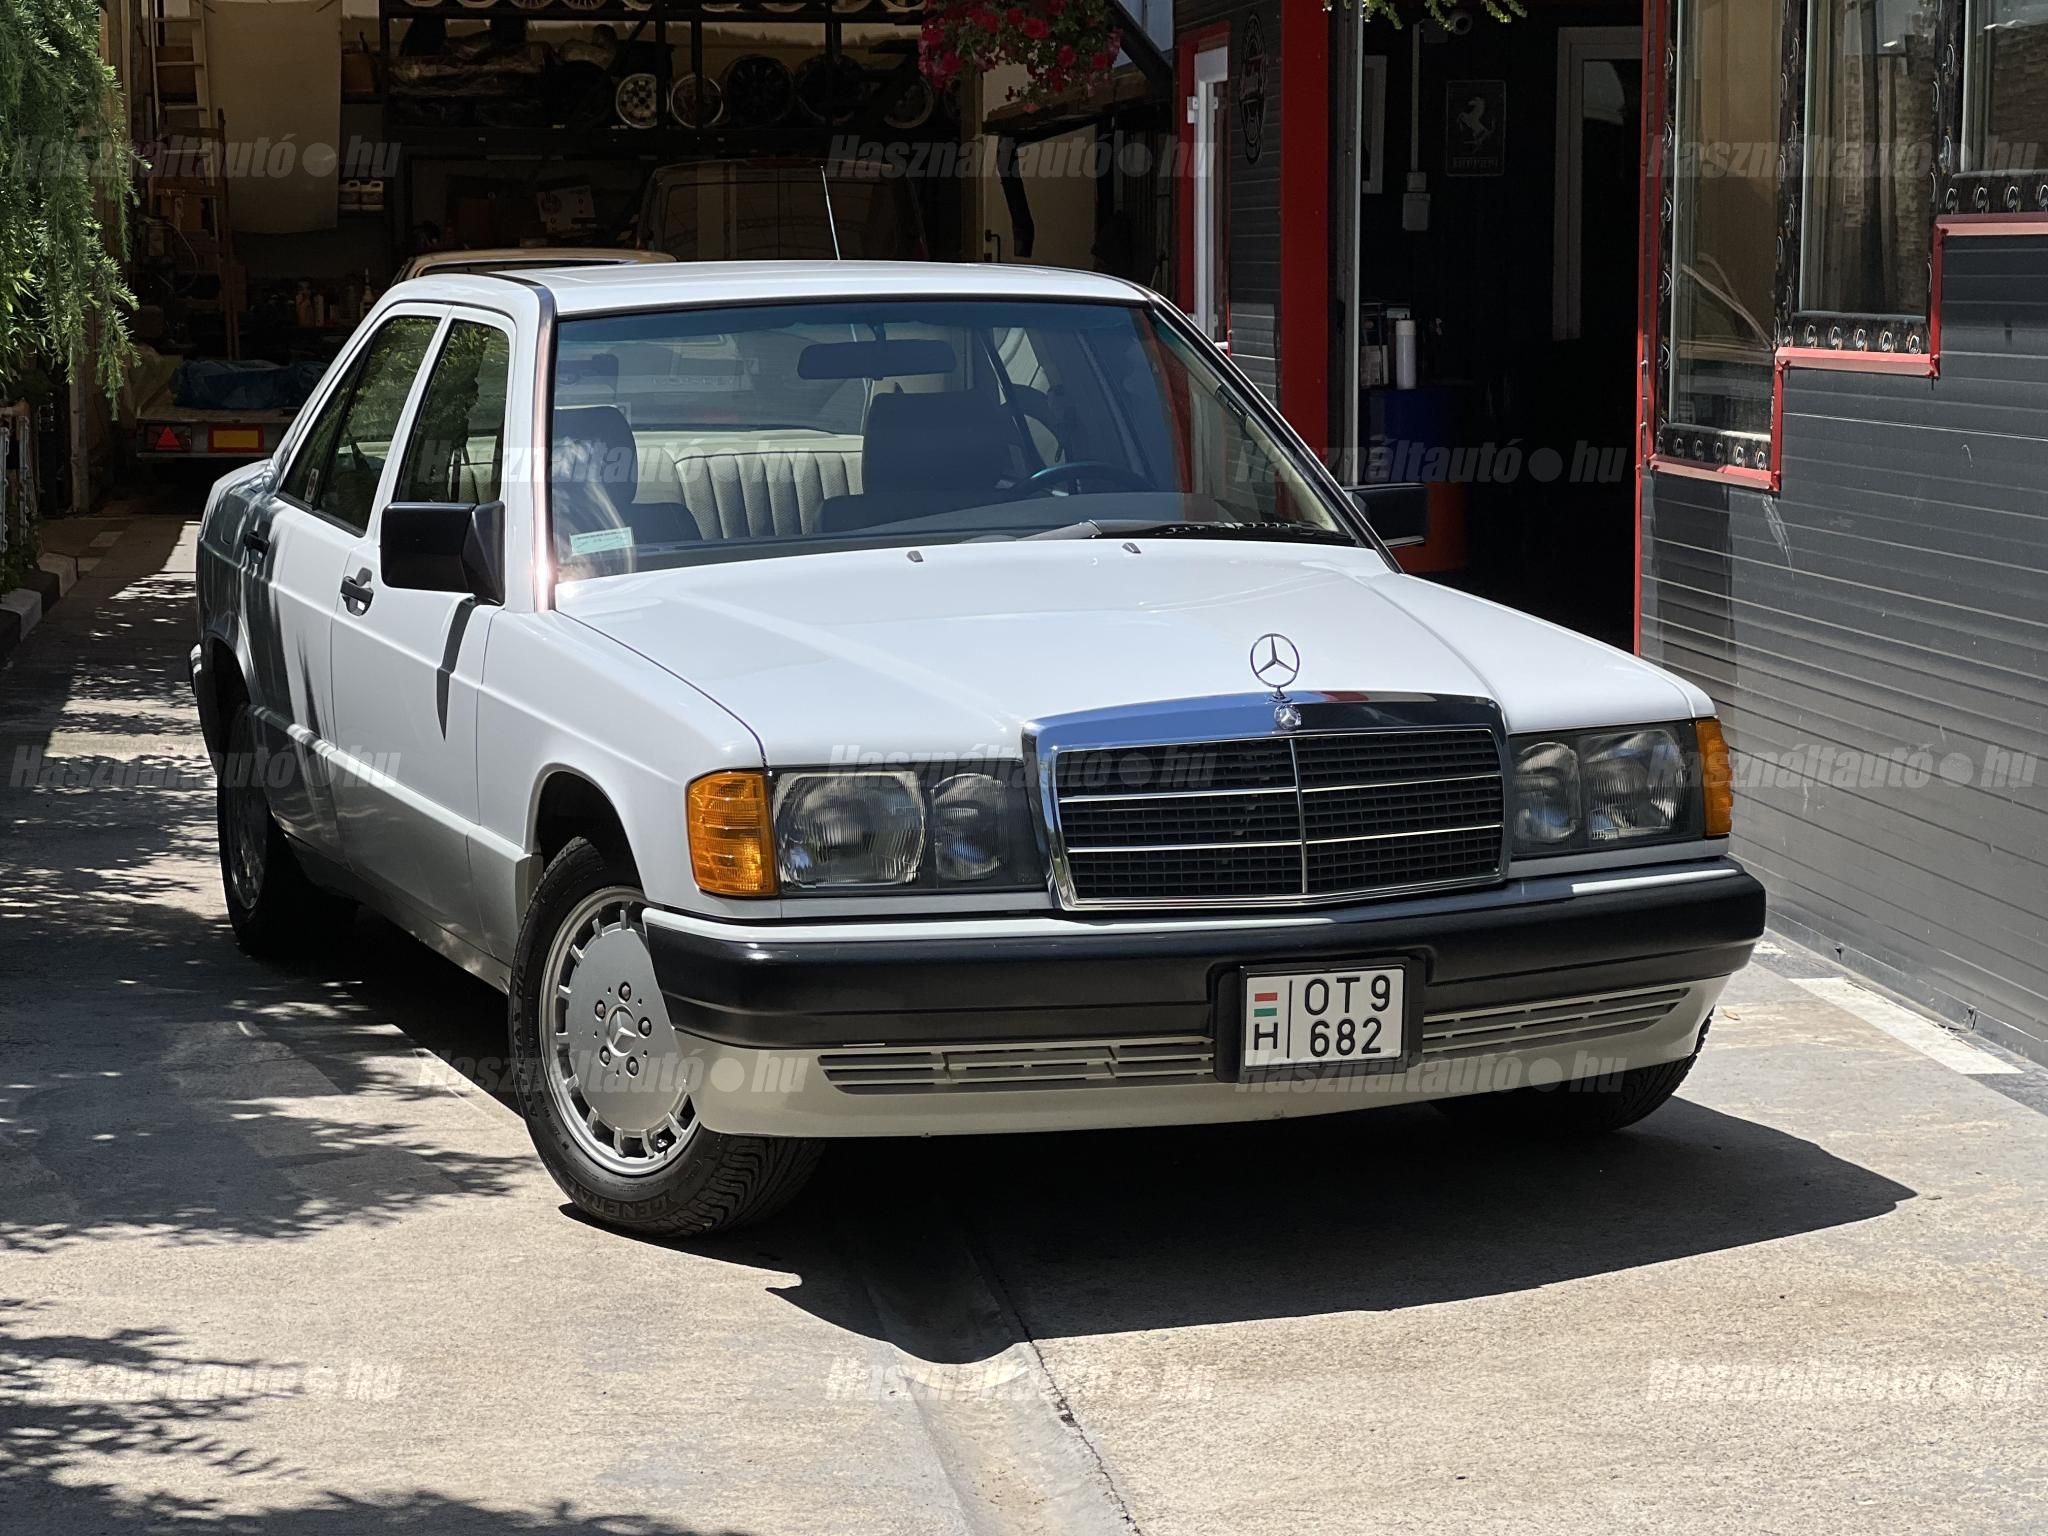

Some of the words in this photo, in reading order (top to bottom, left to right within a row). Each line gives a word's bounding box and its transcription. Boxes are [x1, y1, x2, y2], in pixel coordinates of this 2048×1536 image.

[1253, 1022, 1278, 1050] H
[1310, 1017, 1382, 1057] 682
[566, 1173, 669, 1219] GENERAL
